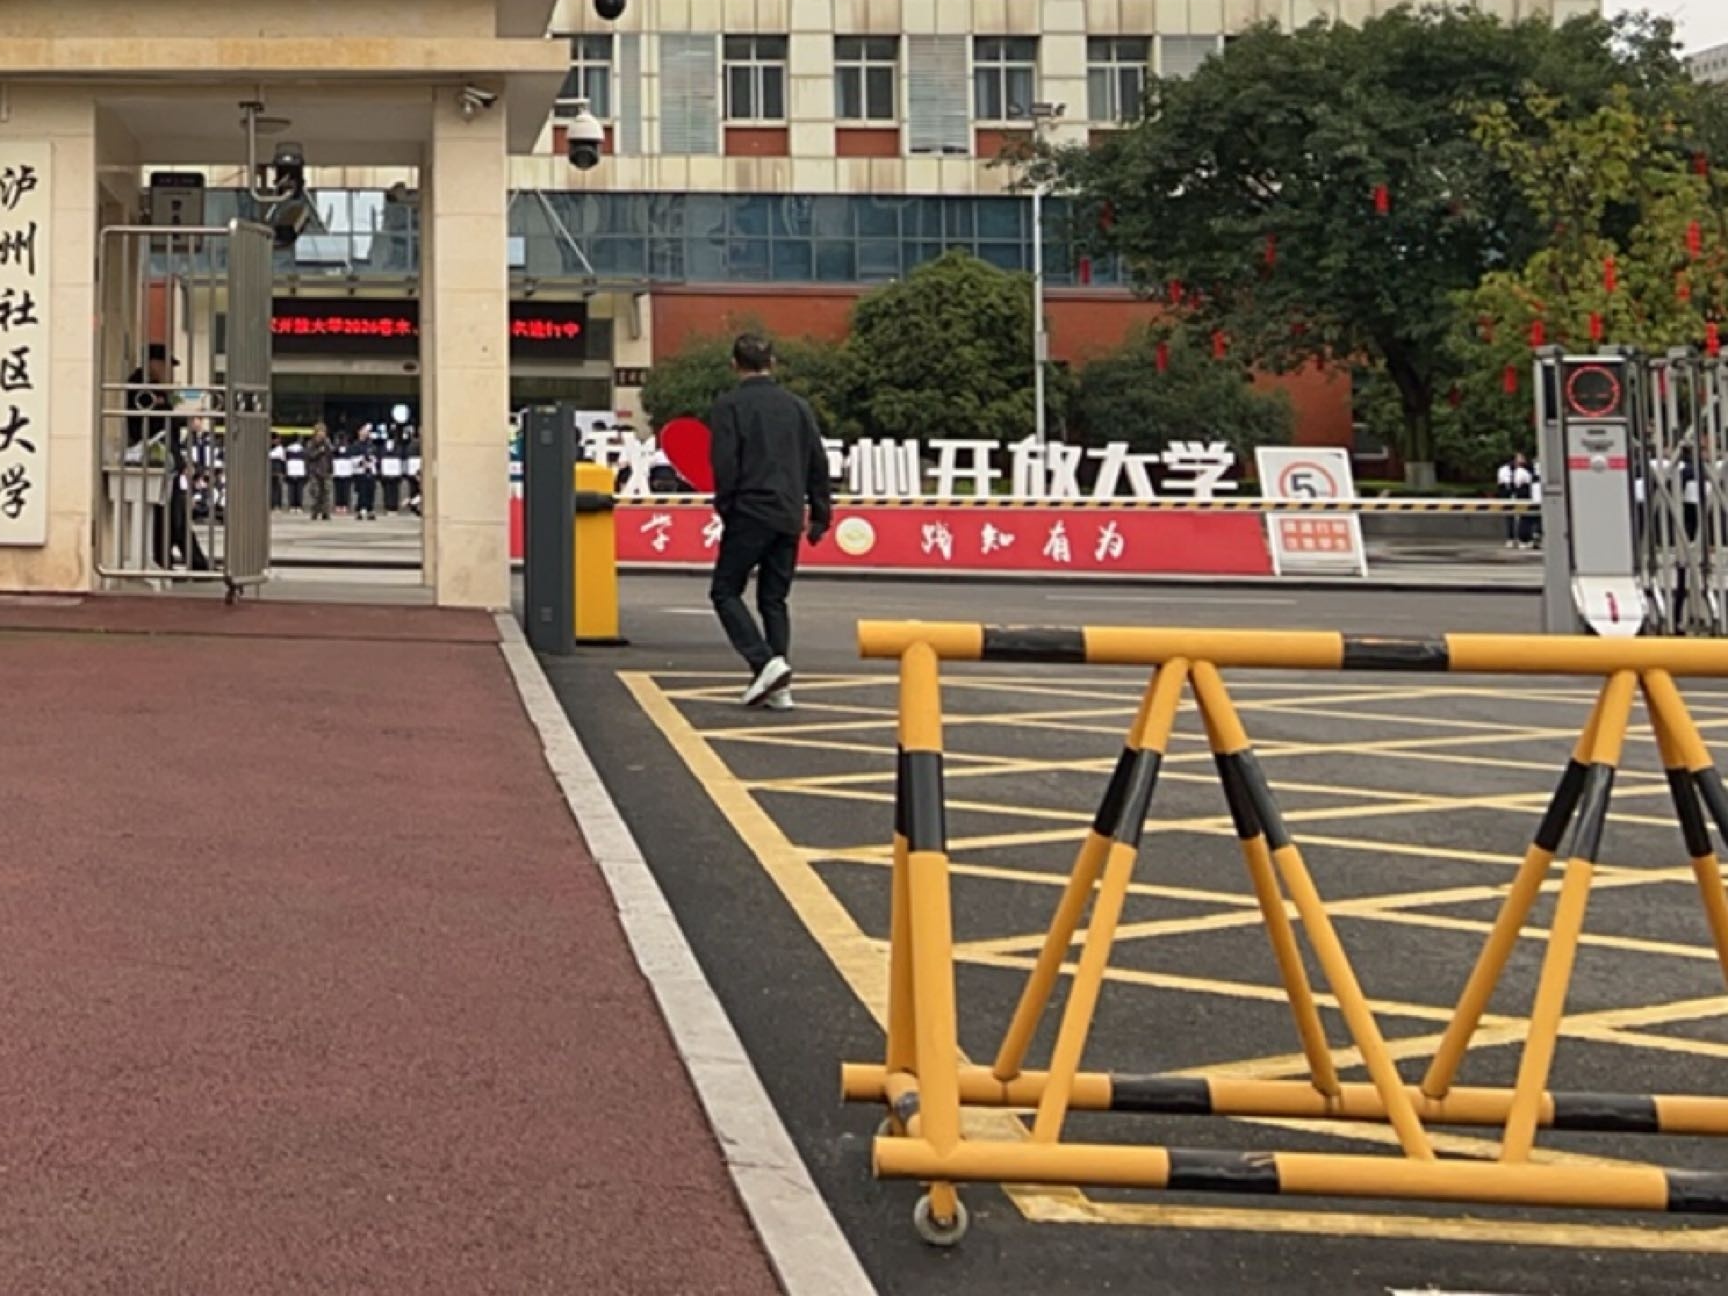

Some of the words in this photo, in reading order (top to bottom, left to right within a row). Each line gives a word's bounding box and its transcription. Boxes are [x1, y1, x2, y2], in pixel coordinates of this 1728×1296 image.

[822, 434, 1239, 496] 州开放大学
